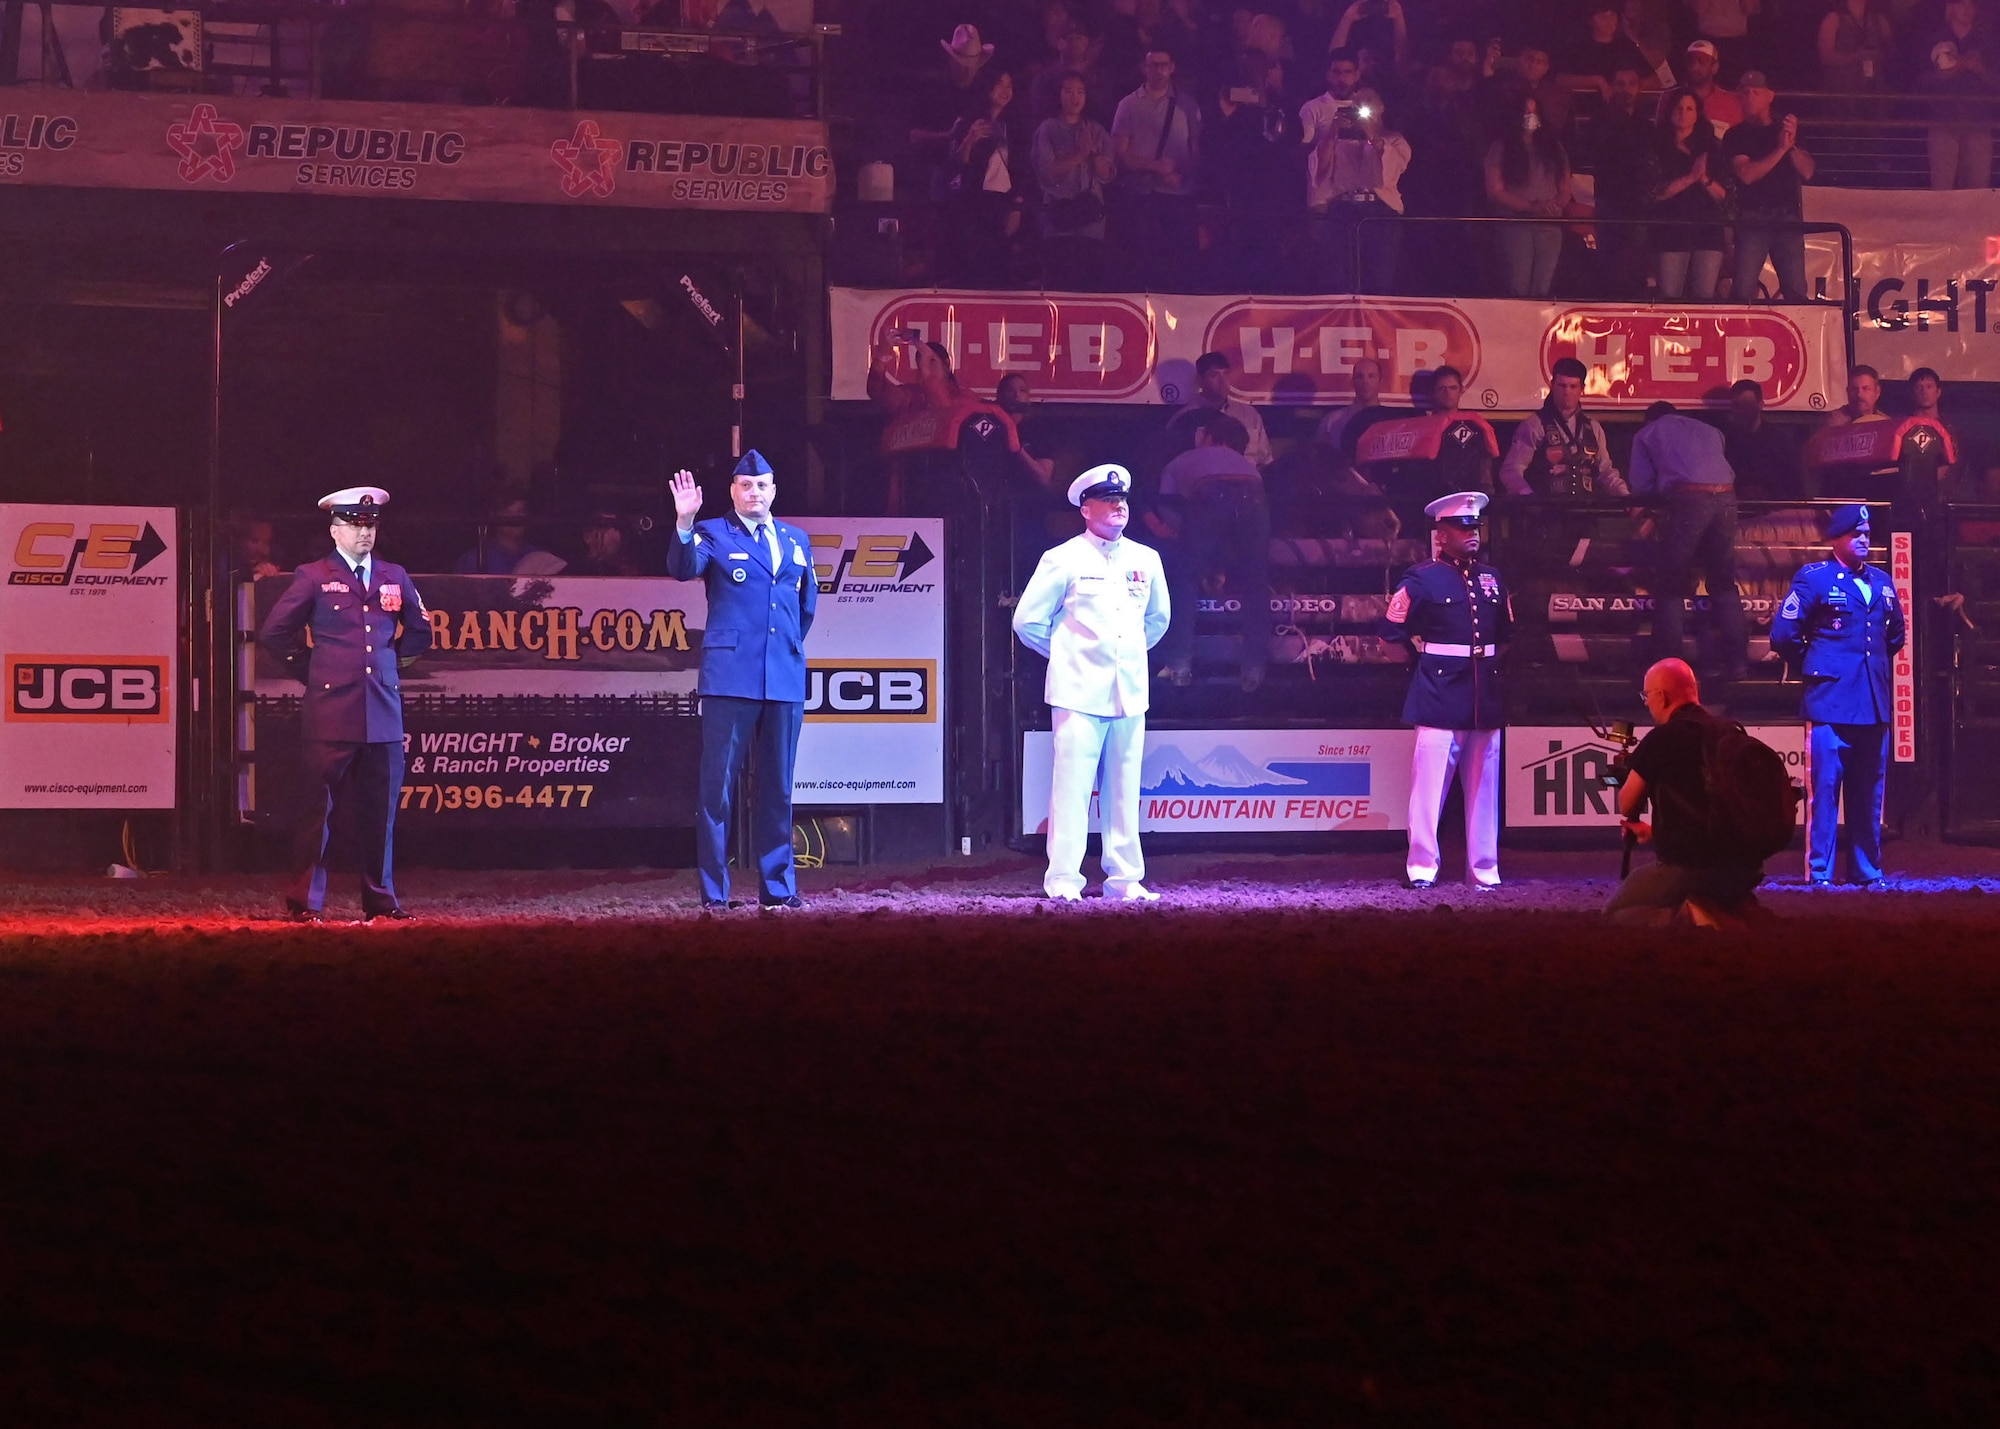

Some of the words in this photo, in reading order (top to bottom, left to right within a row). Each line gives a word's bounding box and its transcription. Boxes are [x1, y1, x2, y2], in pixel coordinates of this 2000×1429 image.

[1, 115, 78, 150] LIC
[247, 125, 465, 165] REPUBLIC
[625, 140, 831, 179] REPUBLIC
[297, 164, 416, 189] SERVICES
[673, 179, 787, 203] SERVICES
[1239, 327, 1447, 376] H-E-B
[1895, 537, 1910, 579] SAN
[13, 574, 64, 584] CISCO
[74, 576, 167, 586] EQUIPMENT
[88, 588, 107, 596] 1978
[842, 583, 935, 594] EQUIPMENT
[1197, 599, 1242, 612] ELO
[1269, 599, 1337, 612] ODEO
[1553, 598, 1605, 611] SAN
[429, 607, 691, 660] RANCH.COM
[18, 667, 157, 710] JCB
[803, 671, 925, 711] JCB
[1896, 685, 1911, 758] RODEO
[420, 733, 523, 753] WRIGHT
[549, 733, 631, 753] Broker
[1318, 745, 1345, 755] Since
[1348, 745, 1370, 755] 1947
[411, 757, 426, 773] &
[433, 756, 498, 773] Ranch
[505, 756, 611, 776] Properties
[25, 782, 148, 797] www.cisco-equipment.com
[794, 780, 916, 792] www.cisco-equipment.com
[400, 784, 594, 813] 77)396-4477
[1148, 799, 1276, 820] MOUNTAIN
[1285, 799, 1370, 820] FENCE
